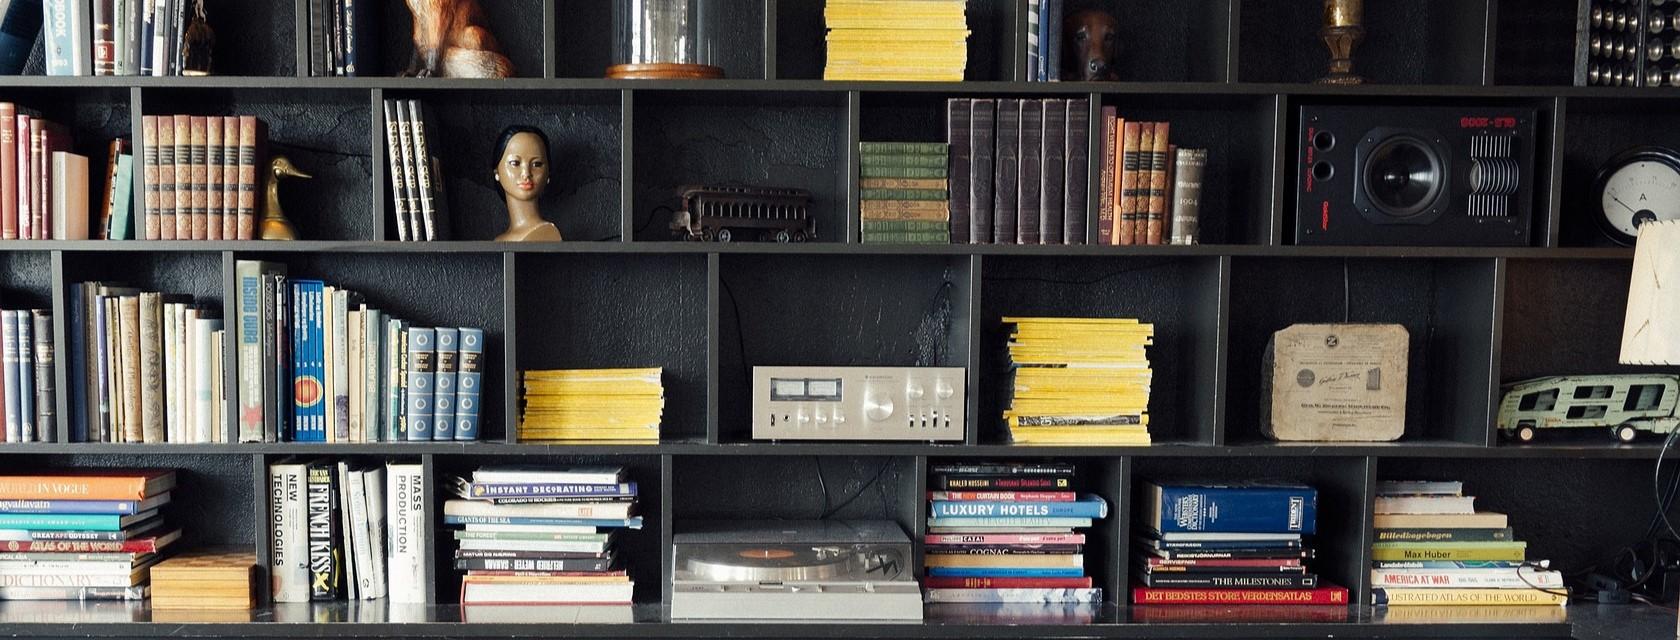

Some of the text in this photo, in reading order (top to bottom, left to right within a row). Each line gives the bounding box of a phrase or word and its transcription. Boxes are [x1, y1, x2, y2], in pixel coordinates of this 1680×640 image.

[1639, 193, 1647, 202] A
[288, 474, 298, 502] NEW
[950, 479, 968, 487] KHALED
[968, 479, 989, 487] HOSSEINI
[53, 484, 89, 495] VOGUE
[412, 475, 422, 511] MASS
[952, 491, 962, 500] THE
[976, 491, 1000, 500] CURTAIN
[1000, 491, 1015, 500] BOOK
[0, 500, 50, 511] gvallavatn
[942, 504, 994, 515] LUXURY
[1001, 504, 1049, 515] HOTELS
[398, 475, 407, 553] PRODUCTION
[273, 474, 284, 567] TECHNOLOGIES
[308, 484, 331, 574] FRENCH KISS
[30, 541, 123, 551] ATLAS OF THE WORLD
[4, 575, 92, 587] DICTIONARY
[1213, 577, 1232, 585] THE
[1235, 577, 1292, 586] MILESTONES
[1384, 575, 1419, 584] AMERICA
[1420, 575, 1430, 584] AT
[1432, 575, 1450, 584] WAR
[1145, 591, 1312, 601] DET BEDSTES STORE VERDENSATLAS
[1389, 593, 1538, 602] USTRATED ATLAS OF THE WORLD
